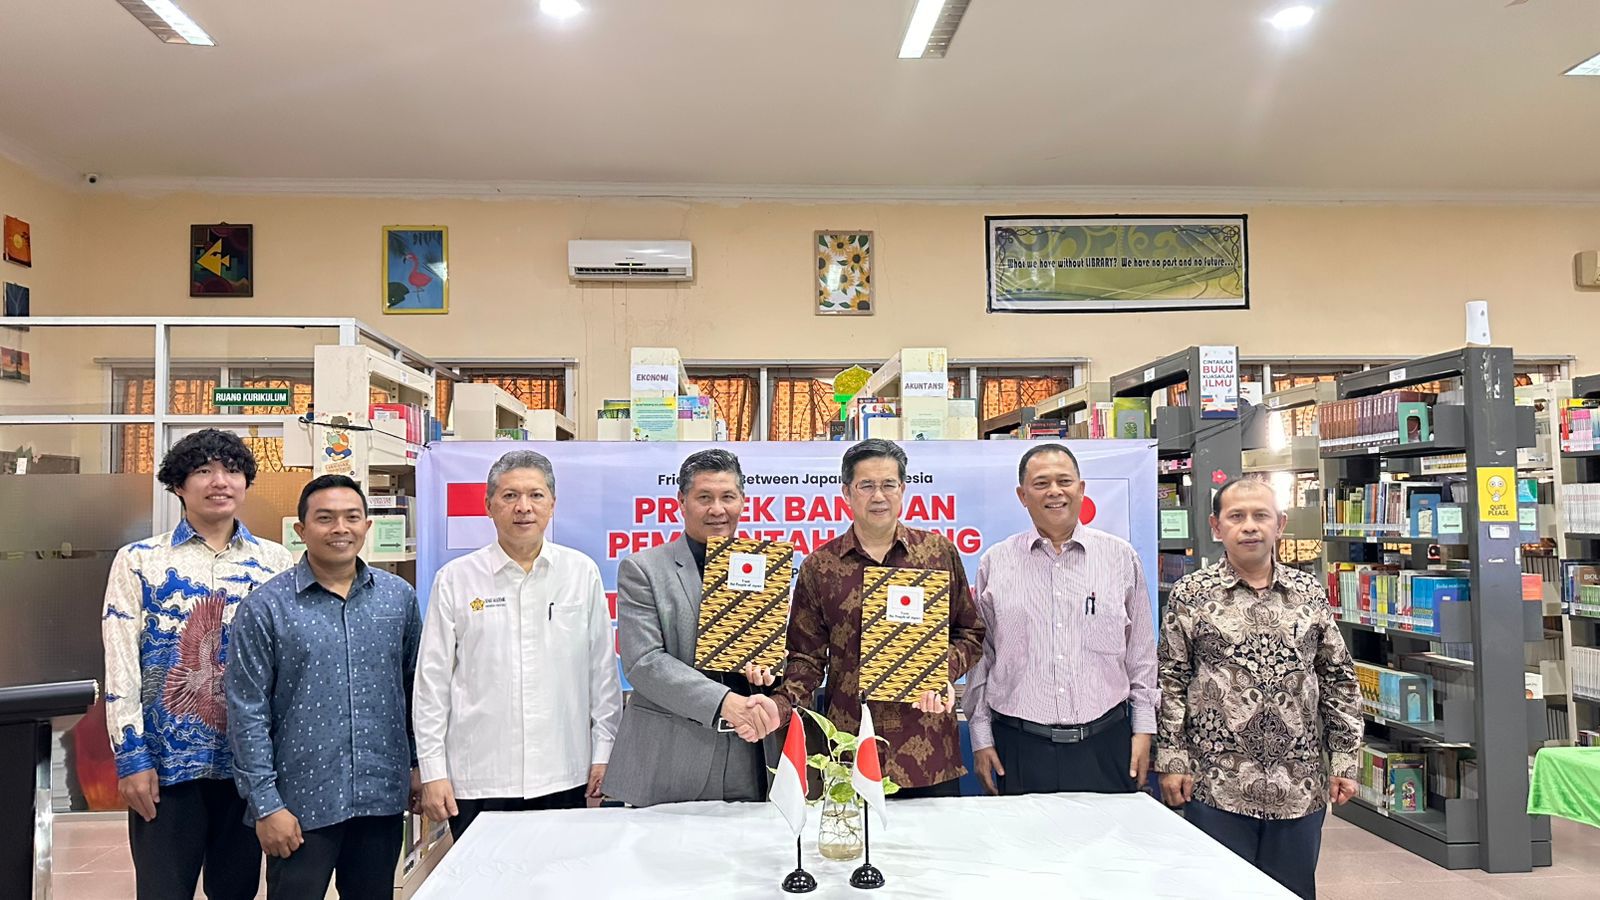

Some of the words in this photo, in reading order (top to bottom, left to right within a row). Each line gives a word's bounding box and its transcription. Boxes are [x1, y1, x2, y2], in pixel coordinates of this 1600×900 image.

[1008, 258, 1025, 268] What
[1040, 259, 1056, 268] have
[1058, 258, 1084, 268] without
[1086, 257, 1117, 268] LIBRARY?
[1121, 258, 1132, 267] We
[1134, 258, 1150, 267] have
[1152, 259, 1161, 267] no
[1162, 257, 1177, 269] past
[1179, 257, 1192, 266] and
[1193, 258, 1203, 267] no
[636, 373, 669, 381] EKONOMI
[905, 382, 944, 390] AKUNTANSI
[215, 392, 242, 402] RUANG
[243, 392, 287, 402] KURIKULUM
[635, 496, 776, 523] PREK
[785, 495, 955, 521] BANAN
